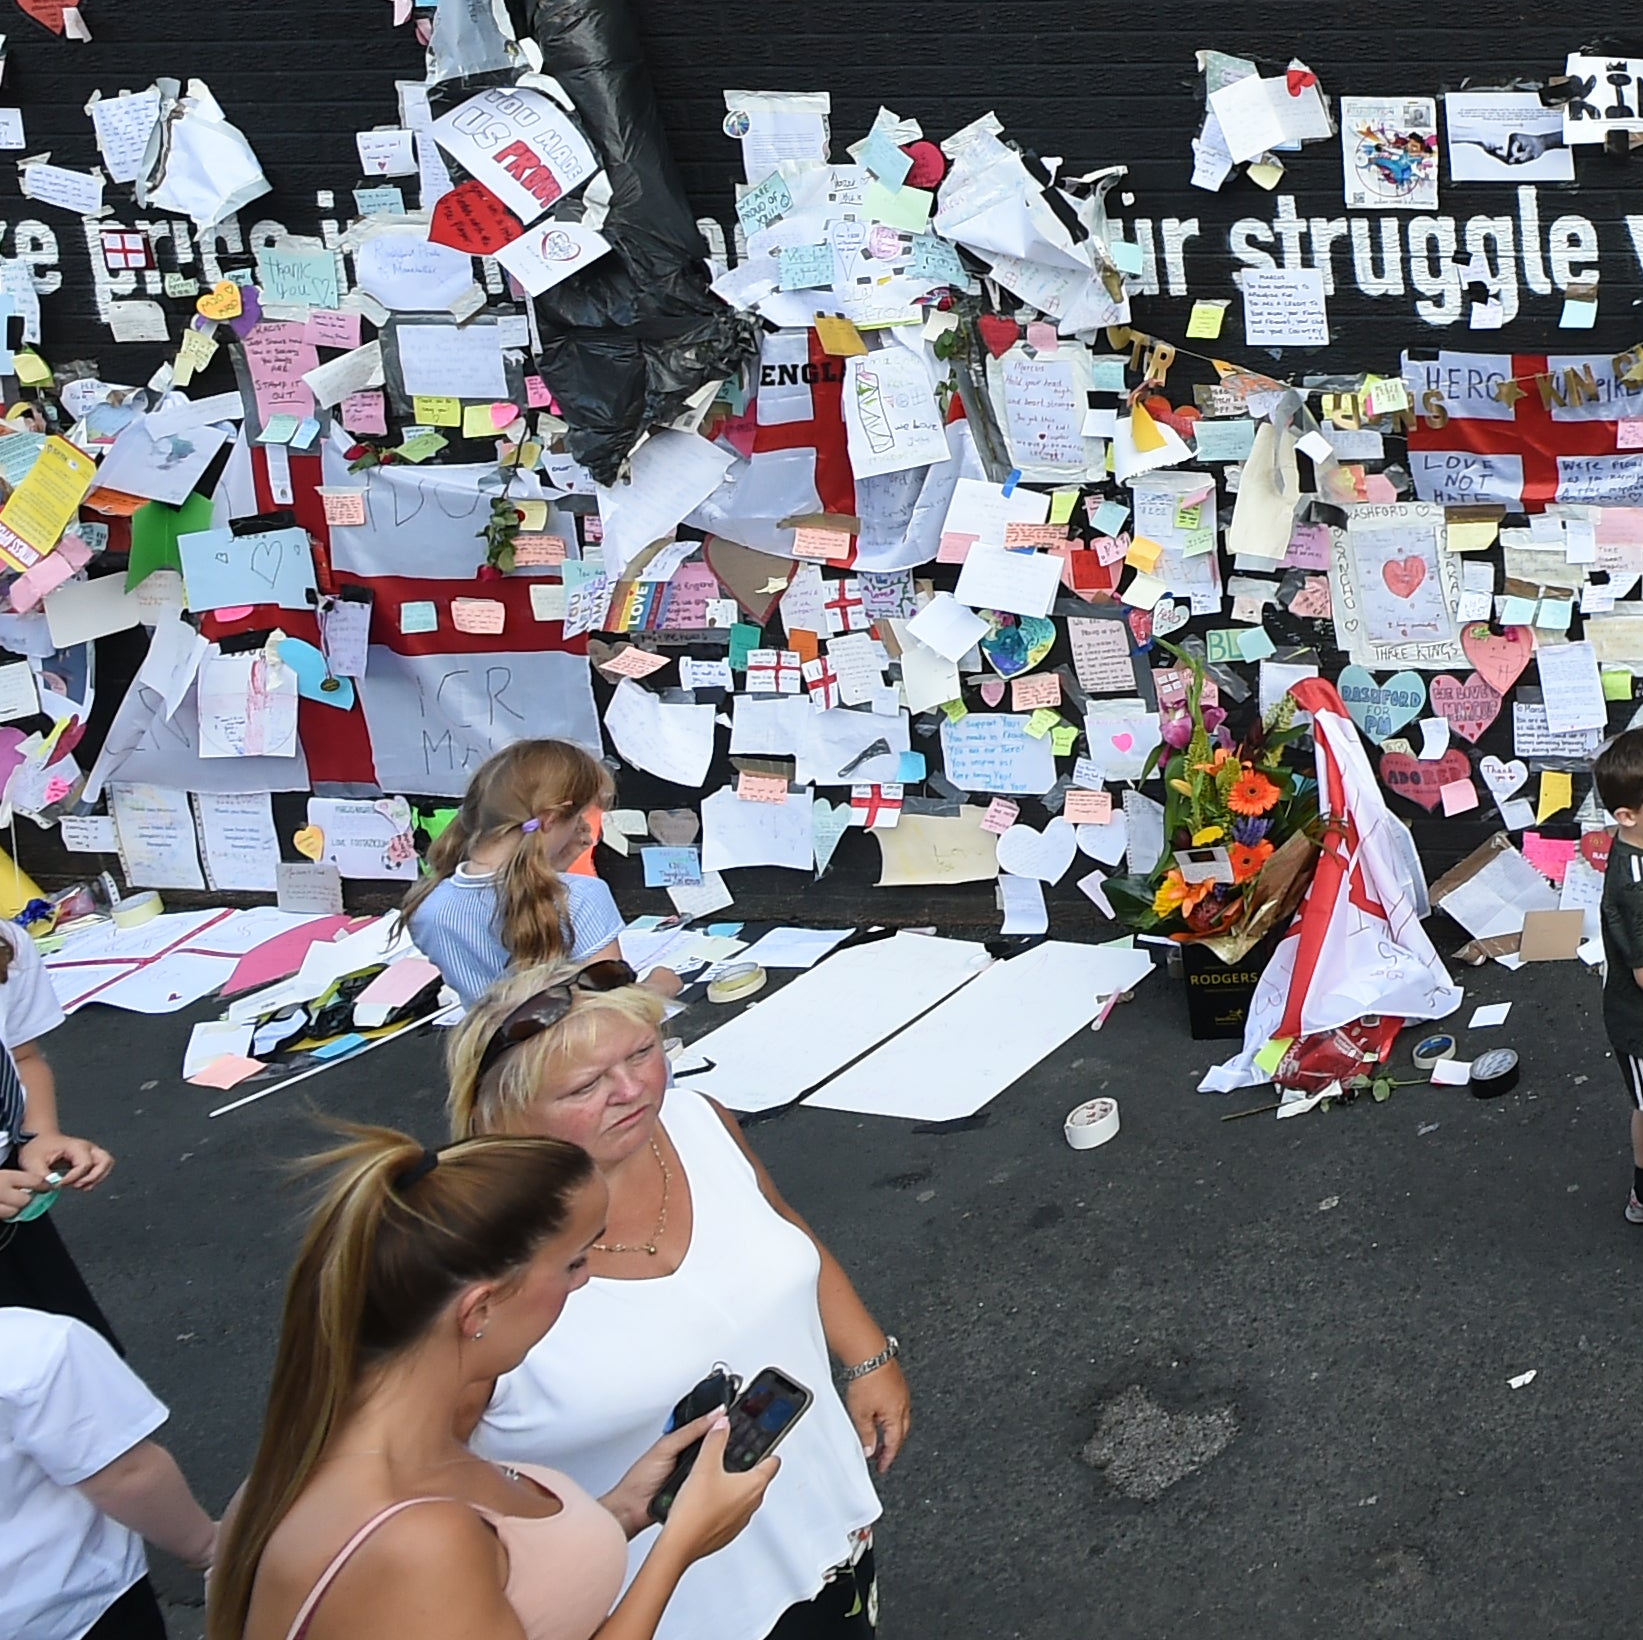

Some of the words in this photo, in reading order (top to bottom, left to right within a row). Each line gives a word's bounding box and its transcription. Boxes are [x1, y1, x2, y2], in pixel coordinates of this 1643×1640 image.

[452, 106, 511, 149] US
[533, 126, 584, 182] MADE
[1229, 186, 1600, 325] struggle
[276, 280, 310, 299] you
[1426, 367, 1505, 401] HERO
[1425, 455, 1492, 471] LOVE
[1444, 473, 1488, 490] NOT
[628, 585, 649, 626] LOVE
[1341, 686, 1421, 708] RASHFORD
[1367, 705, 1390, 715] FOR
[1441, 701, 1502, 722] MARCUS
[1364, 715, 1392, 736] PM
[1388, 768, 1459, 785] ADORED
[1189, 971, 1259, 986] RODGERS
